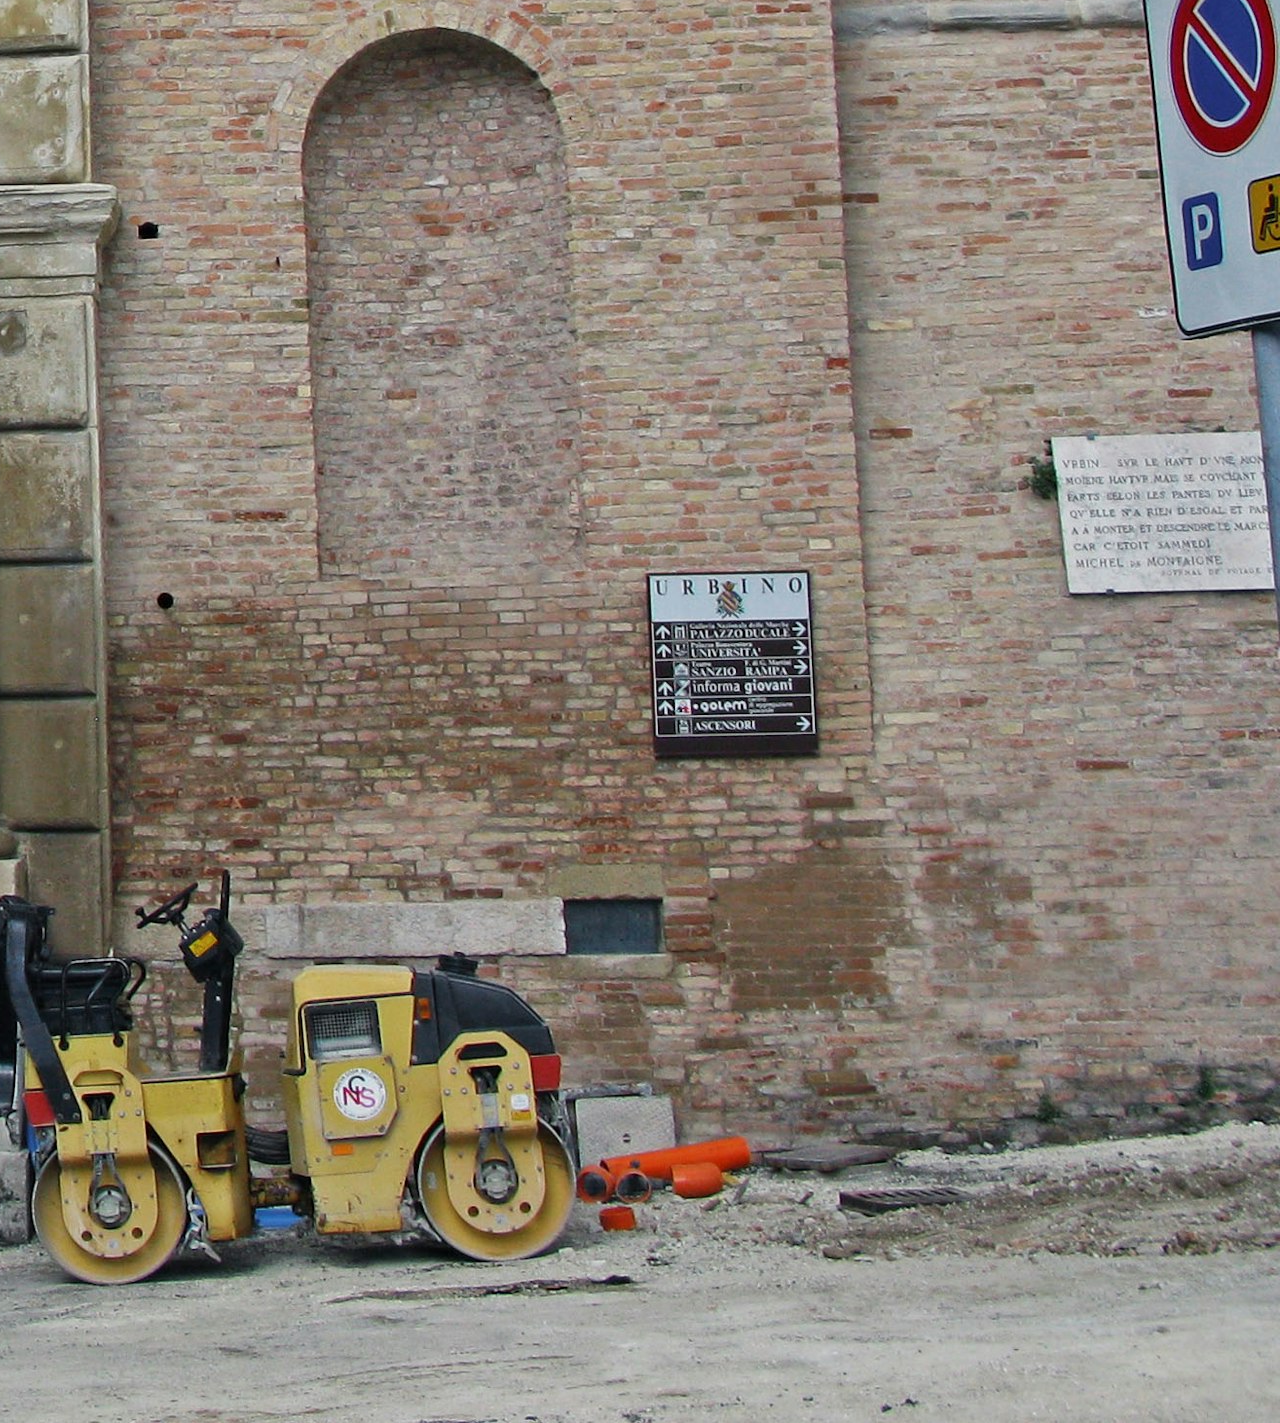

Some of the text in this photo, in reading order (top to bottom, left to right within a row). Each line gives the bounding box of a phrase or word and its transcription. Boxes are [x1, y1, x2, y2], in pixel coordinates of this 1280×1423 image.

[1190, 203, 1214, 261] P
[1145, 458, 1158, 467] LE
[1164, 457, 1193, 466] HAVT
[1146, 490, 1166, 499] LES
[1217, 489, 1232, 497] DV
[1147, 508, 1172, 517] RIEN
[1229, 505, 1243, 514] ET
[1094, 524, 1135, 534] MONTER
[1140, 524, 1152, 533] ET
[1073, 542, 1096, 551] CAR
[1076, 557, 1124, 568] MICHEL
[1146, 555, 1223, 568] MONTAIGNE
[655, 576, 802, 596] URBINO
[689, 627, 791, 639] PALAZZO DUCALE
[690, 647, 762, 658] UNIVERSITA'
[691, 666, 737, 677] SANZIO
[745, 665, 788, 676] RAMPA
[692, 678, 793, 695] informa giovani
[694, 719, 756, 731] ASCENSORI
